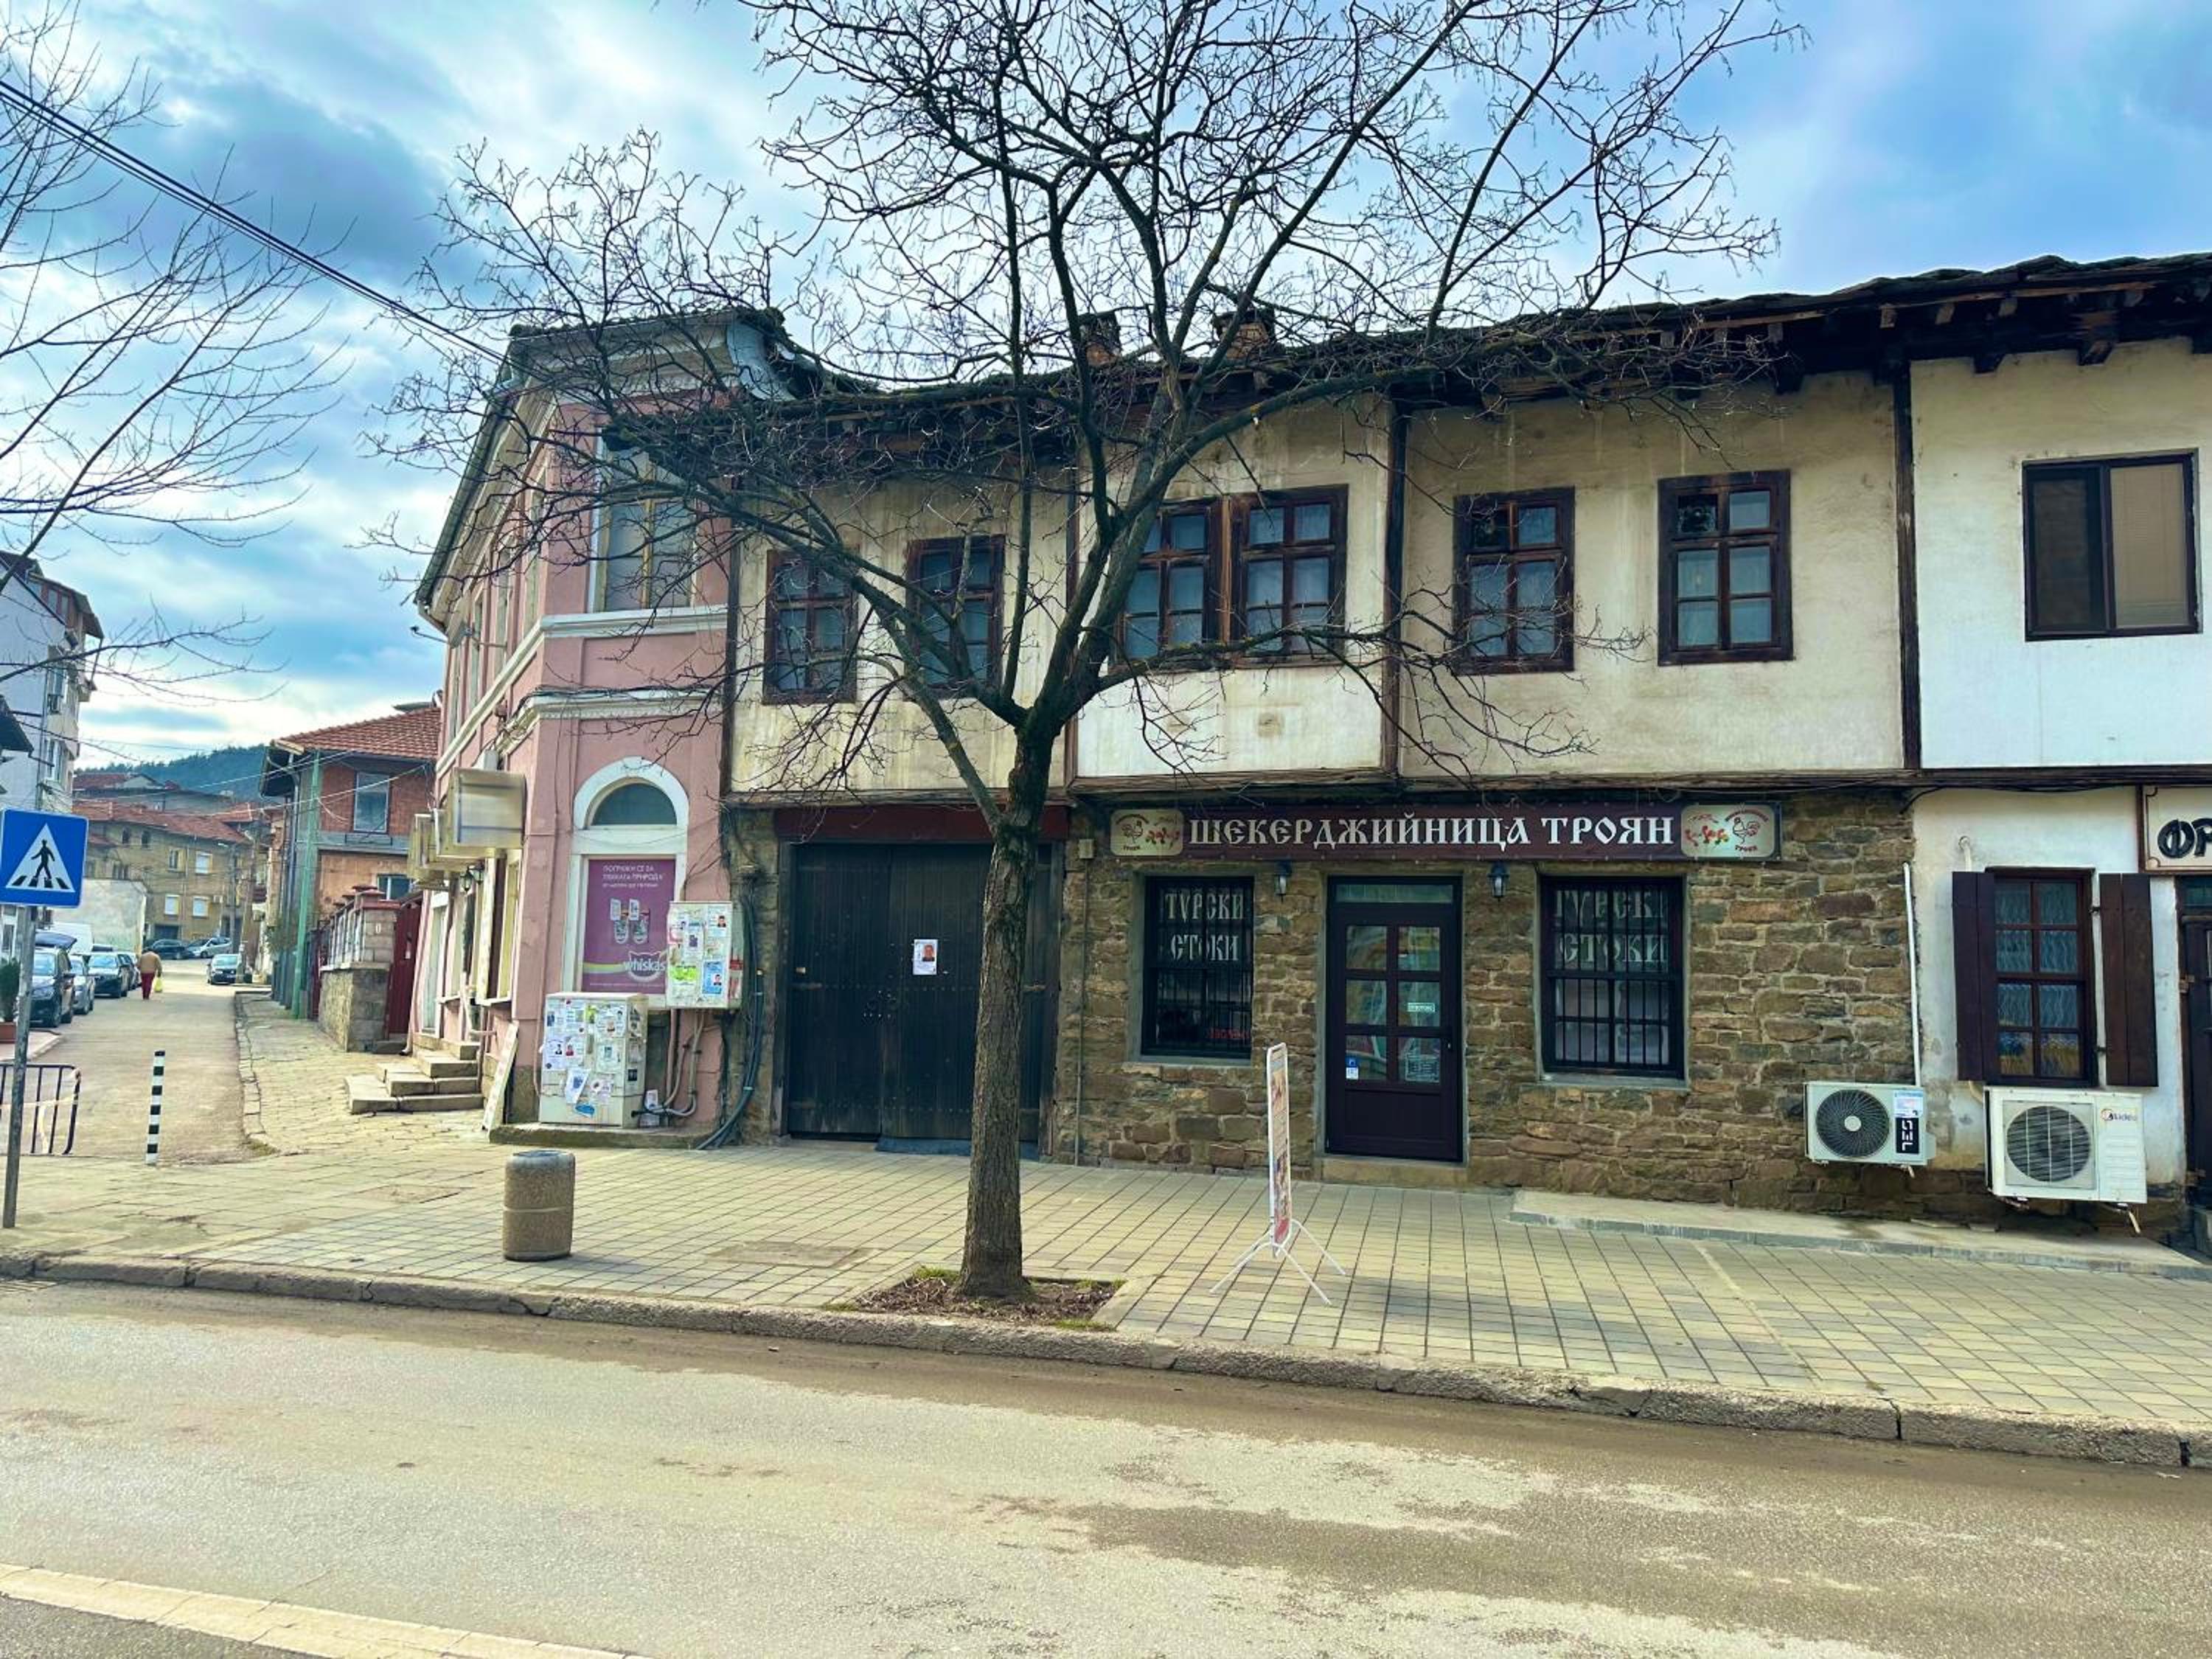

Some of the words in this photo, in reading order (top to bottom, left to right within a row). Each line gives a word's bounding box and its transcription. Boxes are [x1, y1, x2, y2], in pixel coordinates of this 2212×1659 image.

[1189, 812, 1531, 852] ШЕКЕРДЖИЙНИЦА
[1541, 816, 1674, 845] ТРОЯН
[1165, 893, 1244, 922] ТУРСКИ
[1171, 934, 1239, 961] СТОКИ
[624, 958, 666, 972] whiskas
